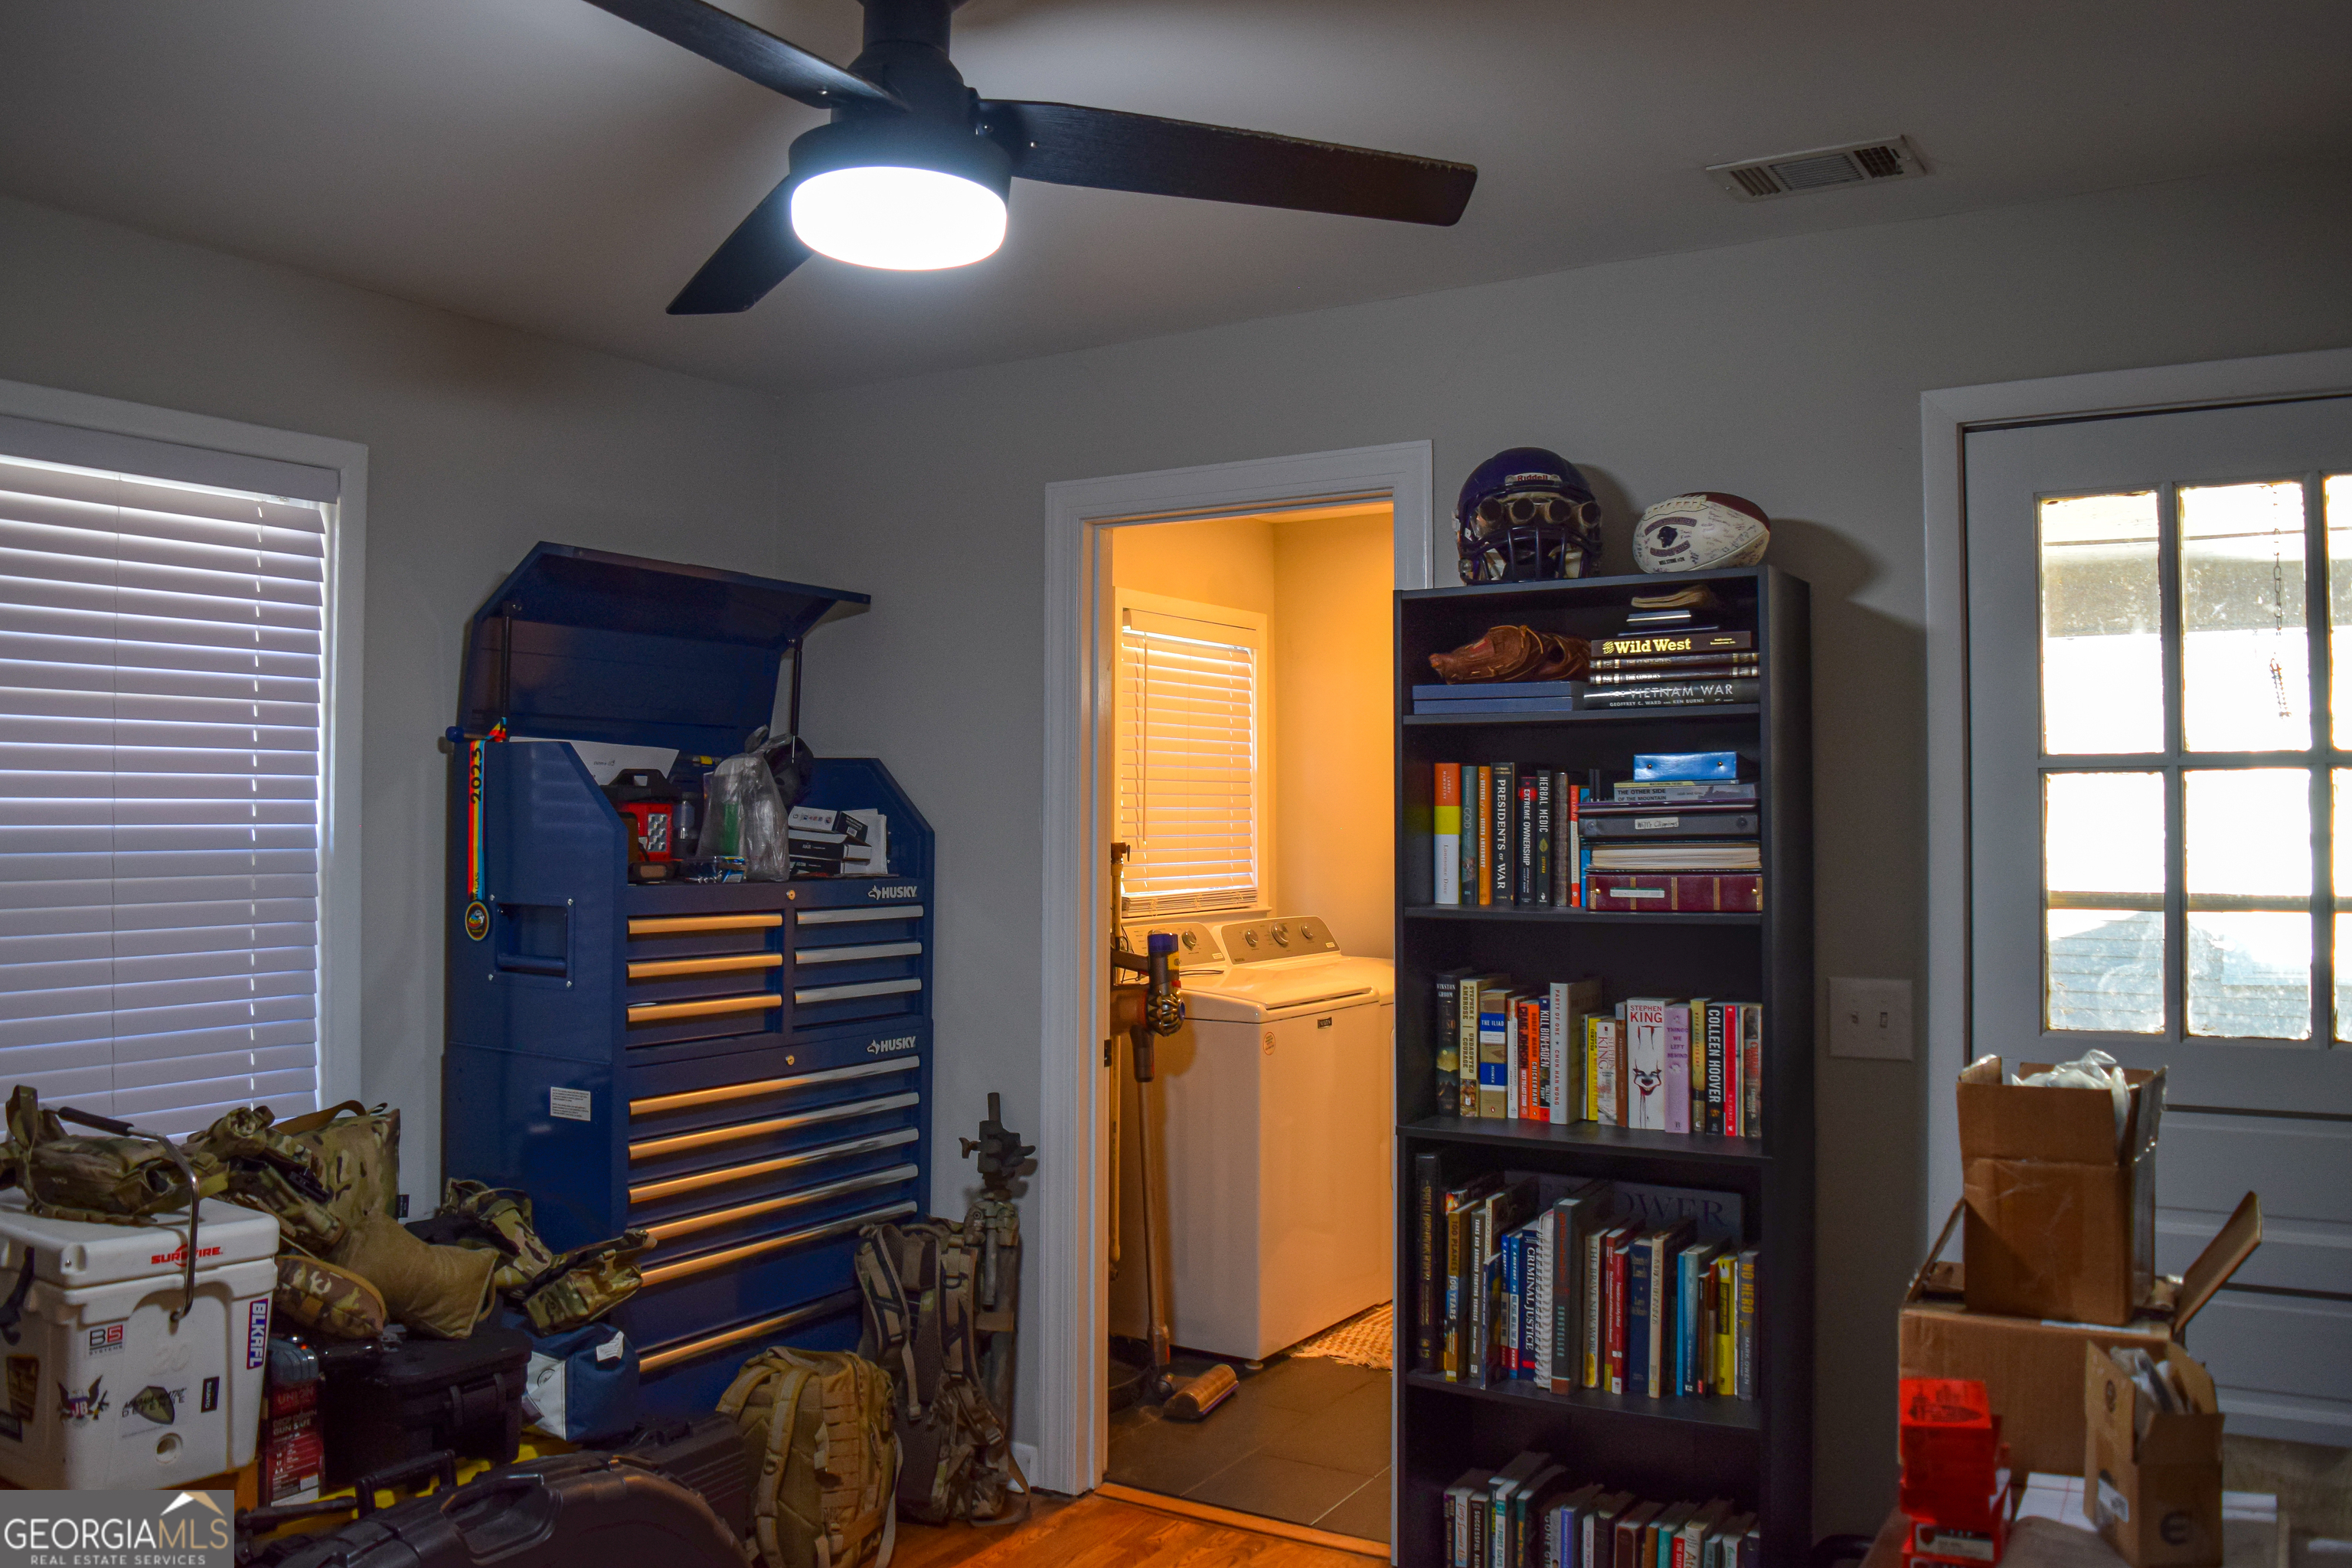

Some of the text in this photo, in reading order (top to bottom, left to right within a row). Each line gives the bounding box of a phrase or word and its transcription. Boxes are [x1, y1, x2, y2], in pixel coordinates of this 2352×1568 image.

[1675, 540, 1690, 554] 2015
[1614, 638, 1691, 654] Wild West
[1629, 684, 1733, 699] VIETNAM WAR
[1497, 779, 1506, 850] PRESIDENTS
[1539, 776, 1548, 832] HERBAL MEDIC
[1463, 807, 1472, 828] GOD
[1497, 863, 1506, 889] WAR
[882, 886, 917, 899] HUSKY
[1631, 1012, 1663, 1023] KING
[880, 1036, 916, 1053] HUSKY
[1519, 1007, 1528, 1069] CRAIG JOHNSON
[1540, 1010, 1550, 1067] KILL BIN LADEN
[1638, 1025, 1662, 1050] IT
[1598, 1036, 1608, 1070] KING
[1708, 1009, 1720, 1103] COLLEEN HOOVER
[1589, 1245, 1598, 1324] THE BRAVE NEW
[1741, 1263, 1754, 1314] NO HERO
[1524, 1246, 1535, 1350] CRIMINAL JUSTICE
[90, 1324, 123, 1347] B5
[249, 1301, 266, 1368] BLKRFL
[90, 1344, 123, 1355] SYSTEMS
